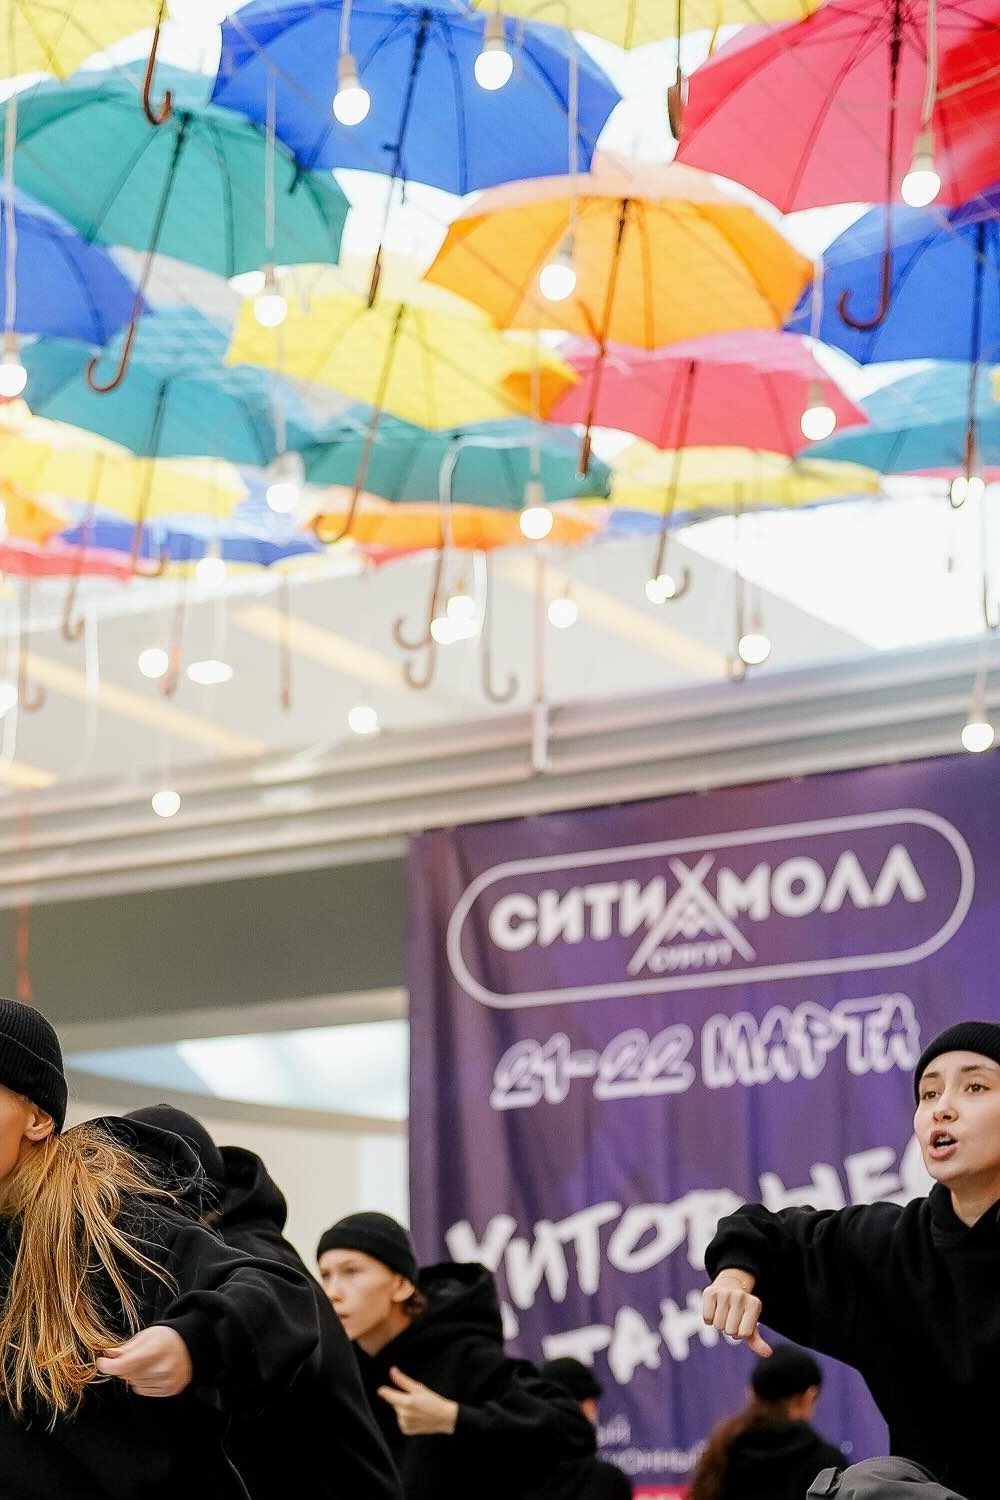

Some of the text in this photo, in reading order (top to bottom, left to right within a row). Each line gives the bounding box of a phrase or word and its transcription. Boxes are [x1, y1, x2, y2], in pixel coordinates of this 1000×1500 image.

[488, 843, 927, 951] СИТИ МОЛЛ
[489, 992, 921, 1111] 21-22 МАРТА
